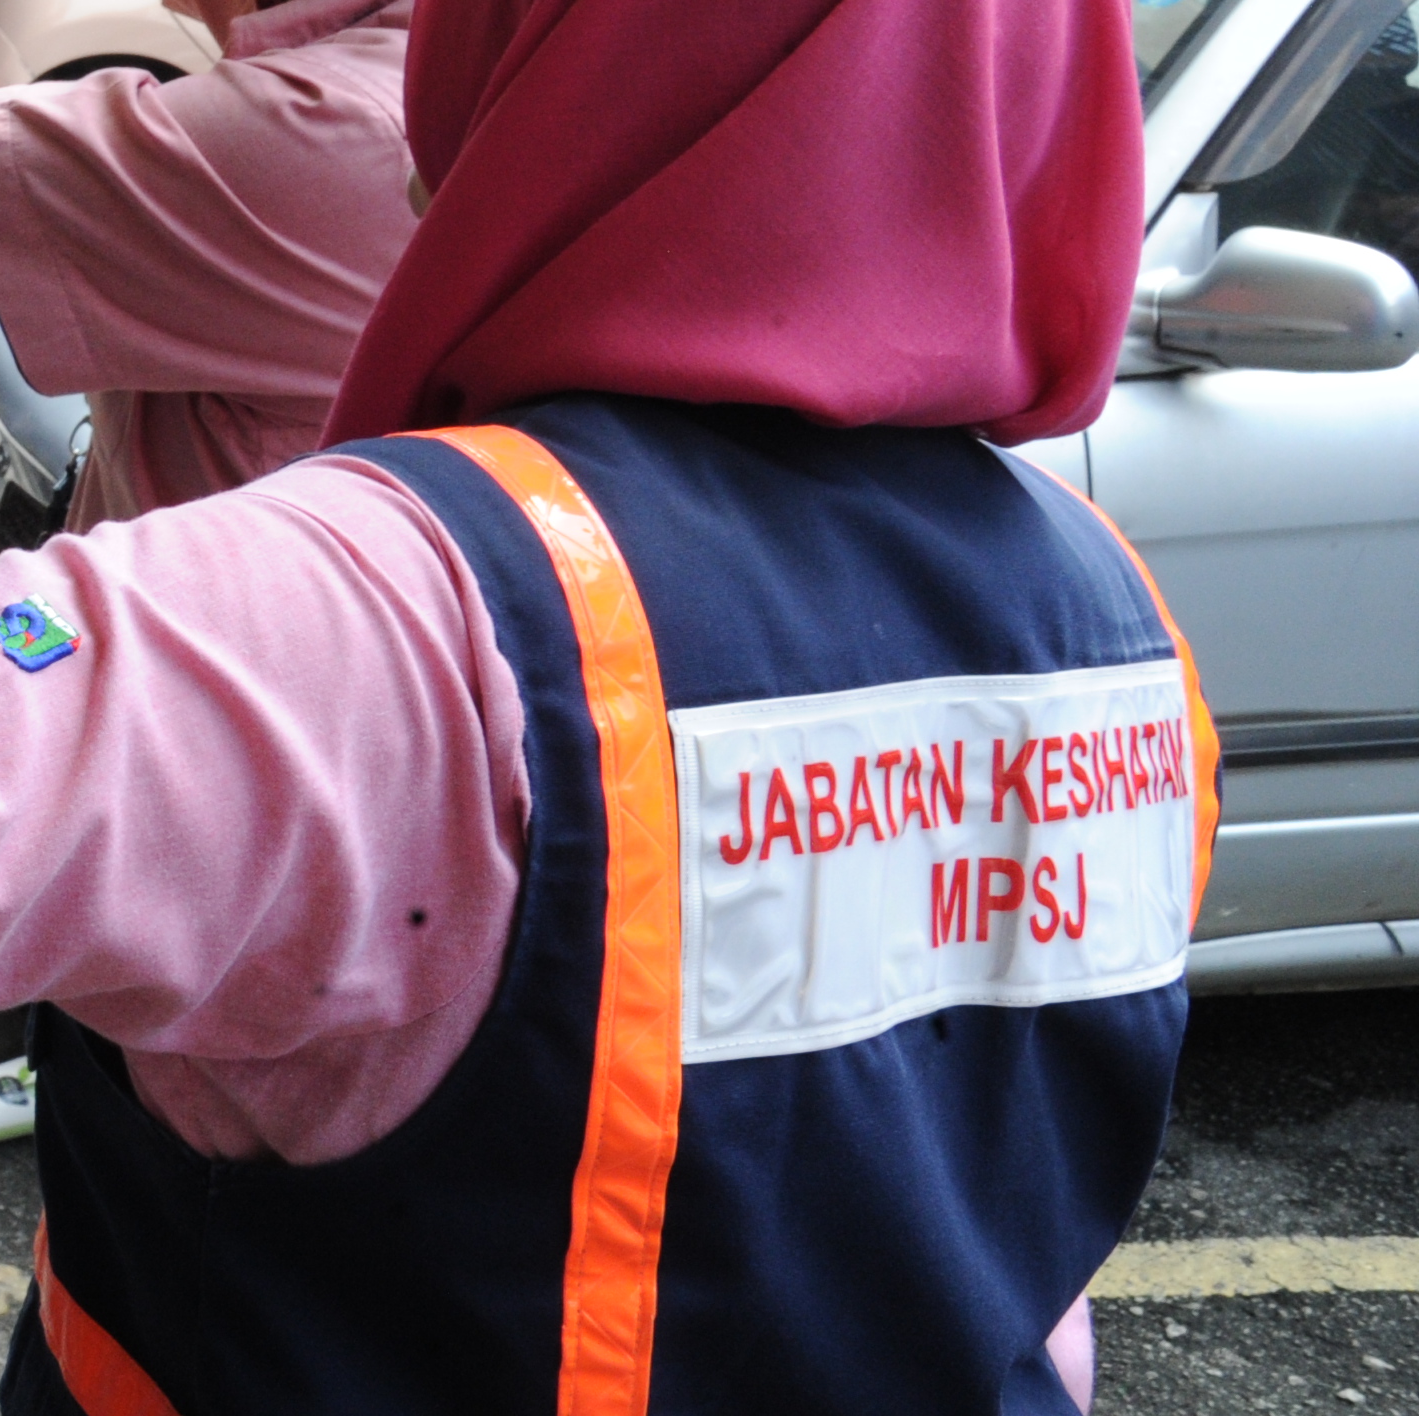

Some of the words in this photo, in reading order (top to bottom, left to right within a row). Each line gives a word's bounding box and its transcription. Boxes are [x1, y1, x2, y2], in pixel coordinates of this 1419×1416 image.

[719, 739, 965, 866] JABATAN
[990, 718, 1190, 825] KESIHATAN
[930, 852, 1086, 949] MPSJ
